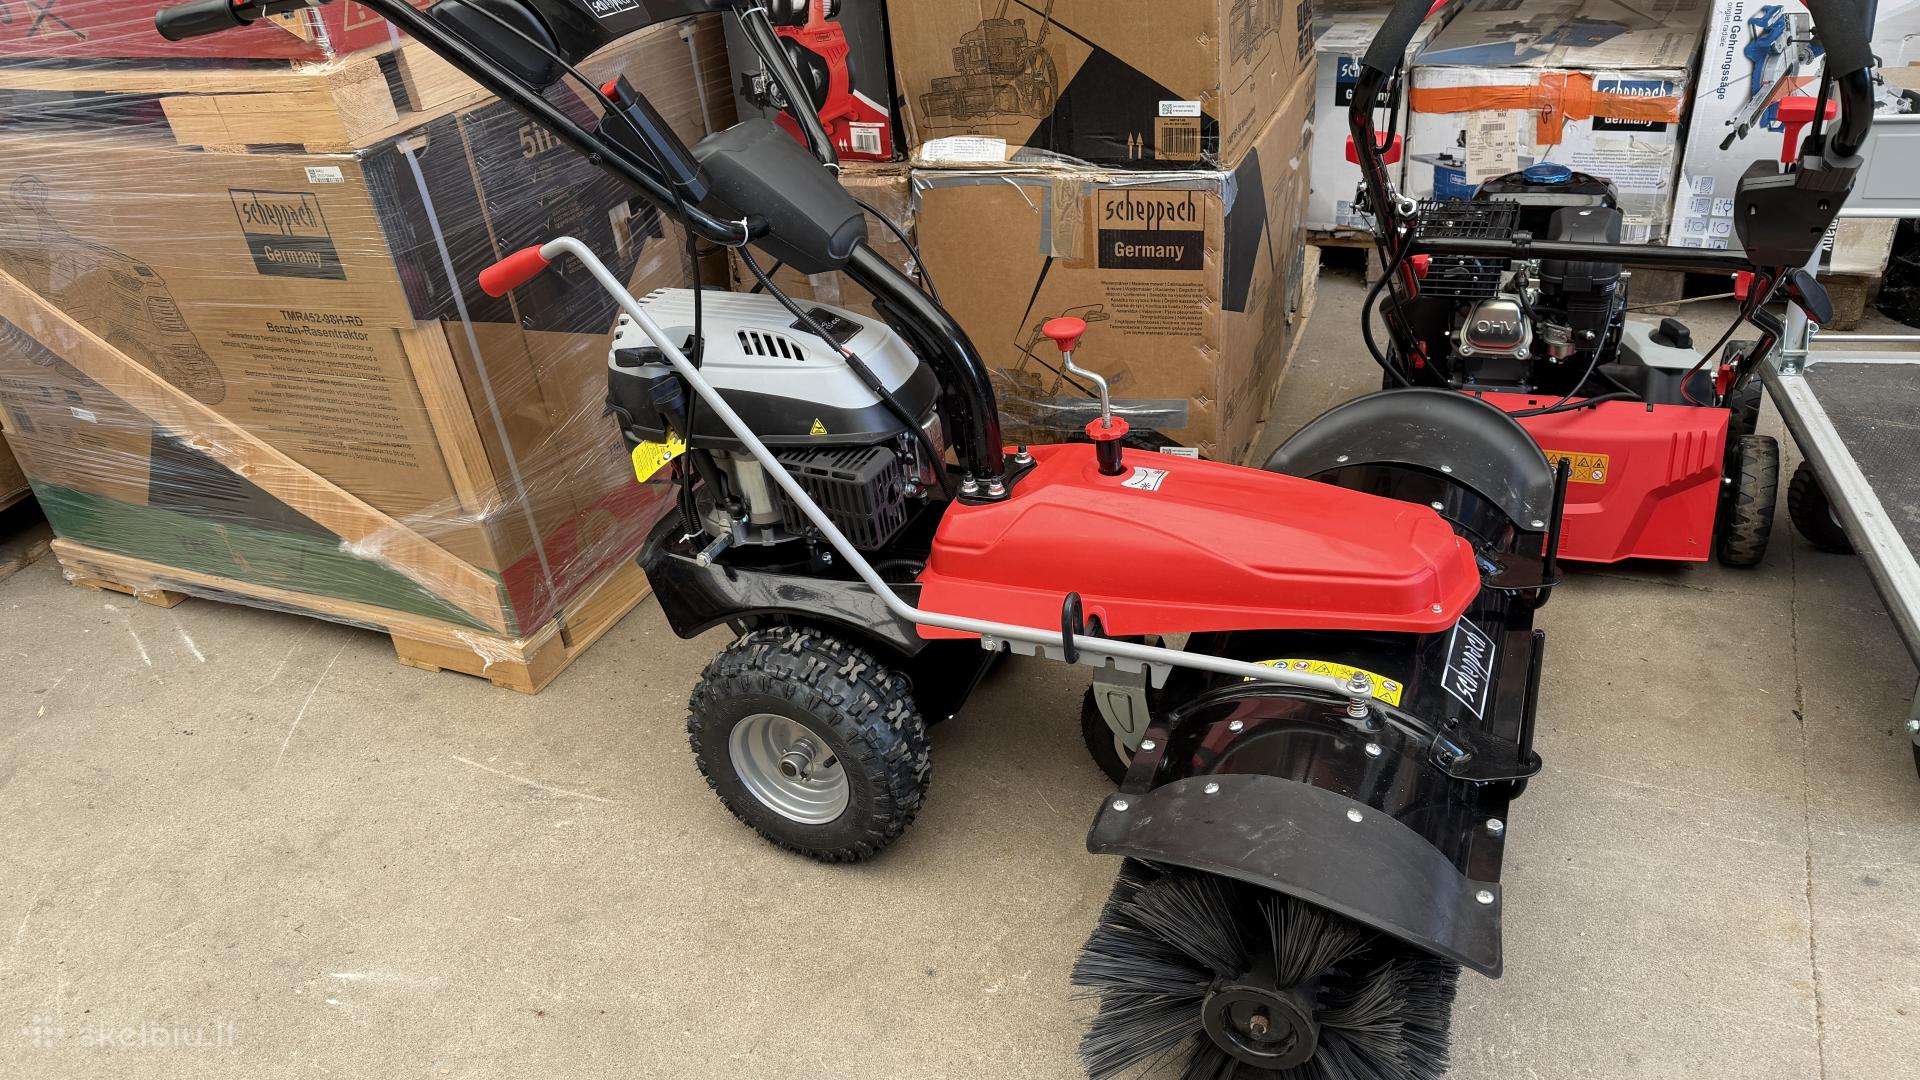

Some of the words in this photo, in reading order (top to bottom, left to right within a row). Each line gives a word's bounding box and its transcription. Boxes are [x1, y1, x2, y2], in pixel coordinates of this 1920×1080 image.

[1735, 2, 1744, 21] und
[1717, 25, 1741, 100] Gehrungssäge
[242, 191, 318, 236] scheppach
[1105, 190, 1196, 231] scheppach
[263, 245, 322, 269] Germany
[1113, 241, 1185, 262] Germany
[279, 310, 364, 327] TMR452-98H-RD
[1477, 320, 1517, 335] OHV
[266, 322, 369, 341] Benzin-Rasentraktor
[1448, 624, 1488, 703] scheppach
